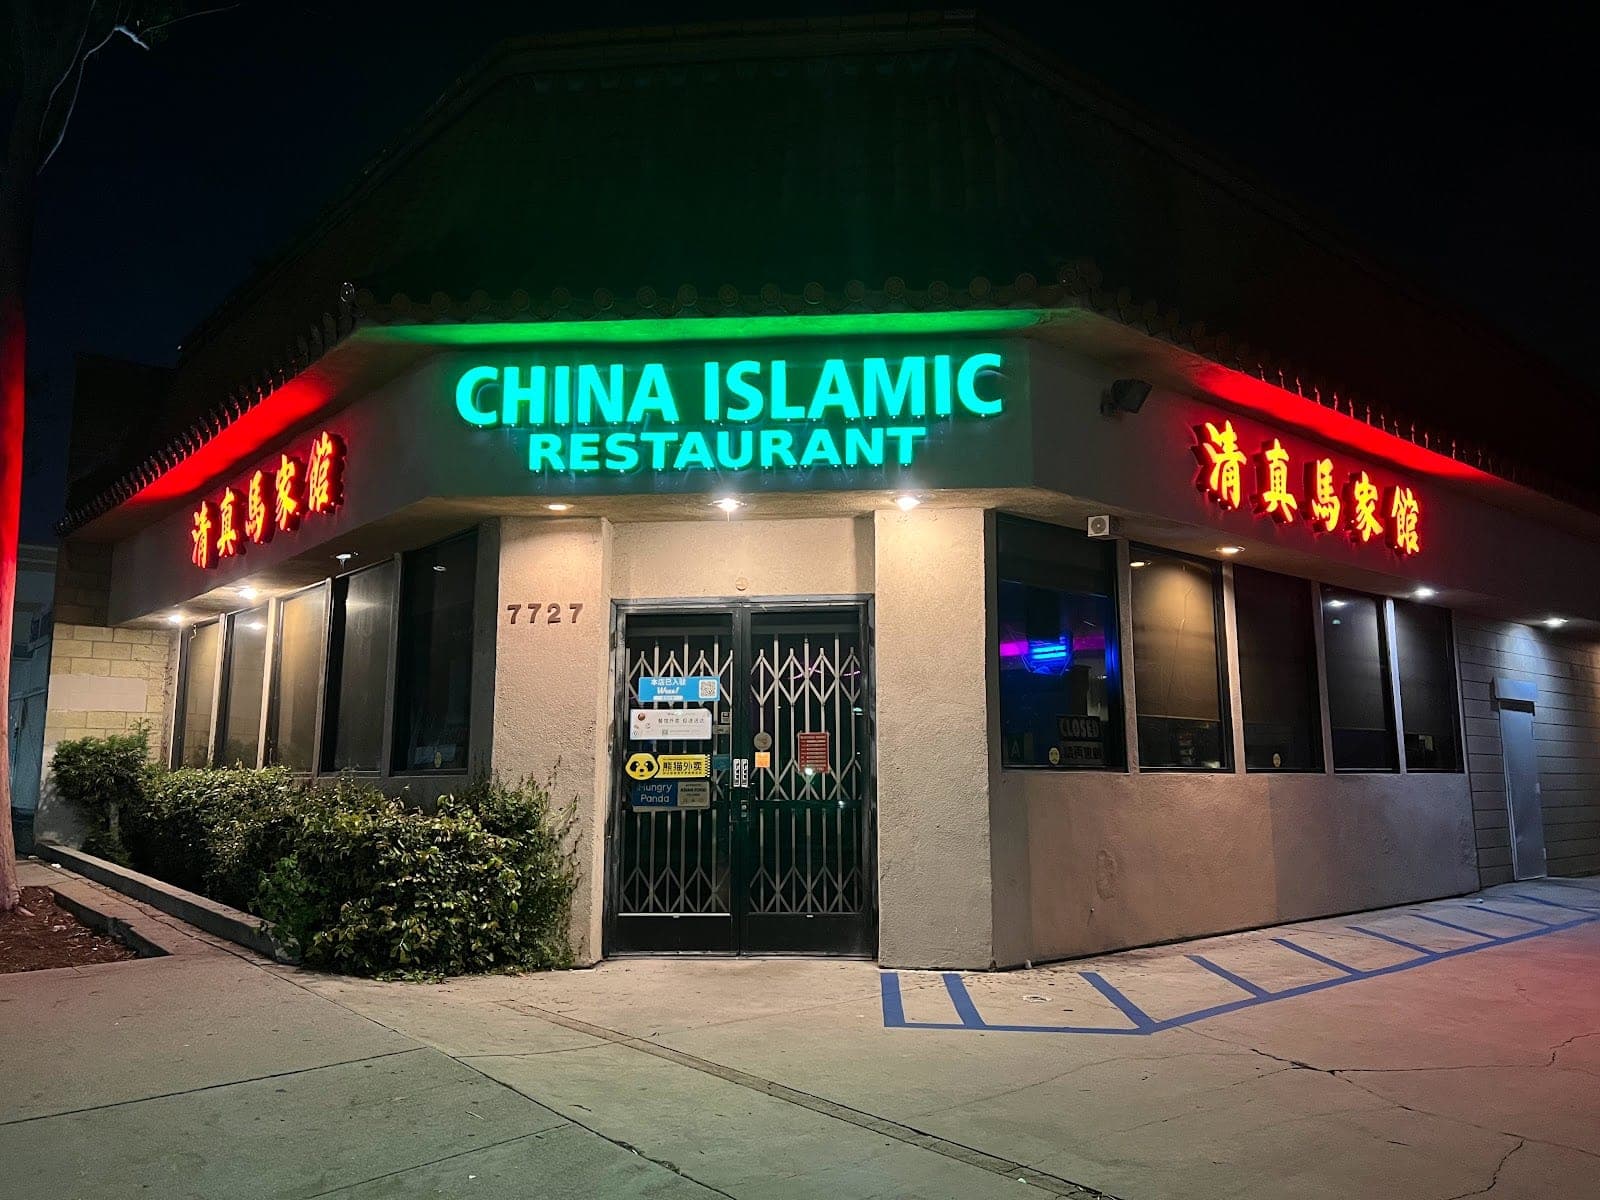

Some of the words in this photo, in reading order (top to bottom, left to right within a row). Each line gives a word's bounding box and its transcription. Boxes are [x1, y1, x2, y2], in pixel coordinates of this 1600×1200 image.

[455, 363, 680, 425] CHINA
[704, 353, 1002, 421] ISLAMIC
[528, 426, 926, 470] RESTAURANT
[1202, 419, 1420, 555] 清真馬家館
[191, 431, 333, 569] 清真馬家館
[507, 603, 583, 625] 7727
[1060, 717, 1100, 738] CLOSED
[663, 761, 702, 771] 熊猫外卖
[638, 783, 673, 794] Hungry
[640, 794, 670, 803] Panda
